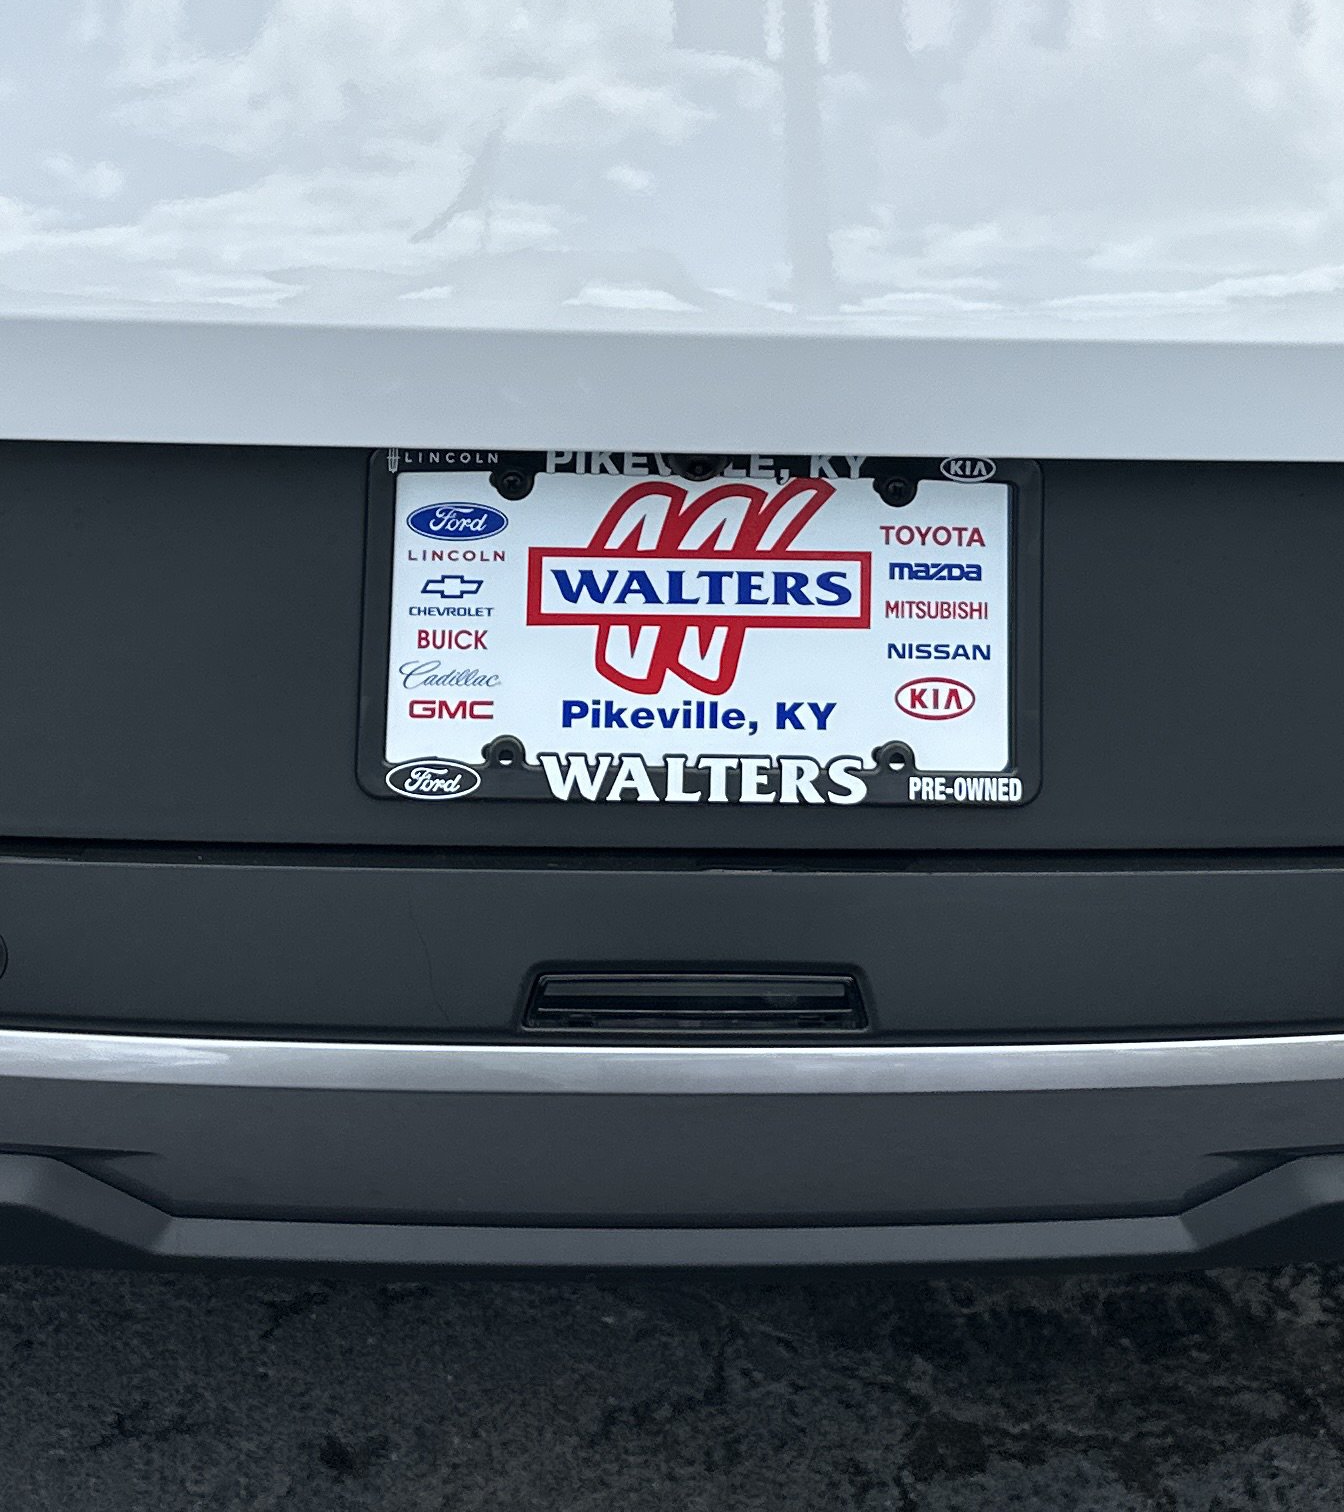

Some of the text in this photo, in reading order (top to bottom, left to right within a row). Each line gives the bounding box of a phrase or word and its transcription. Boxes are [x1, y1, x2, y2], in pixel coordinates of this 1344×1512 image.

[404, 451, 499, 464] LINCOLN
[810, 454, 867, 480] KY
[879, 524, 986, 548] TOYOTA
[407, 549, 506, 563] LINCOLN
[550, 569, 852, 607] WALTERS
[408, 605, 495, 617] CHEVROLET
[885, 600, 989, 620] MITSUBISHI
[416, 628, 488, 651] BUICK
[887, 642, 992, 661] NISSAN
[398, 659, 502, 690] Cadillac
[408, 699, 495, 720] GMC
[561, 698, 837, 736] Pikeville, KY
[537, 752, 869, 805] WALTERS
[908, 775, 1023, 802] PRE-OWNED
